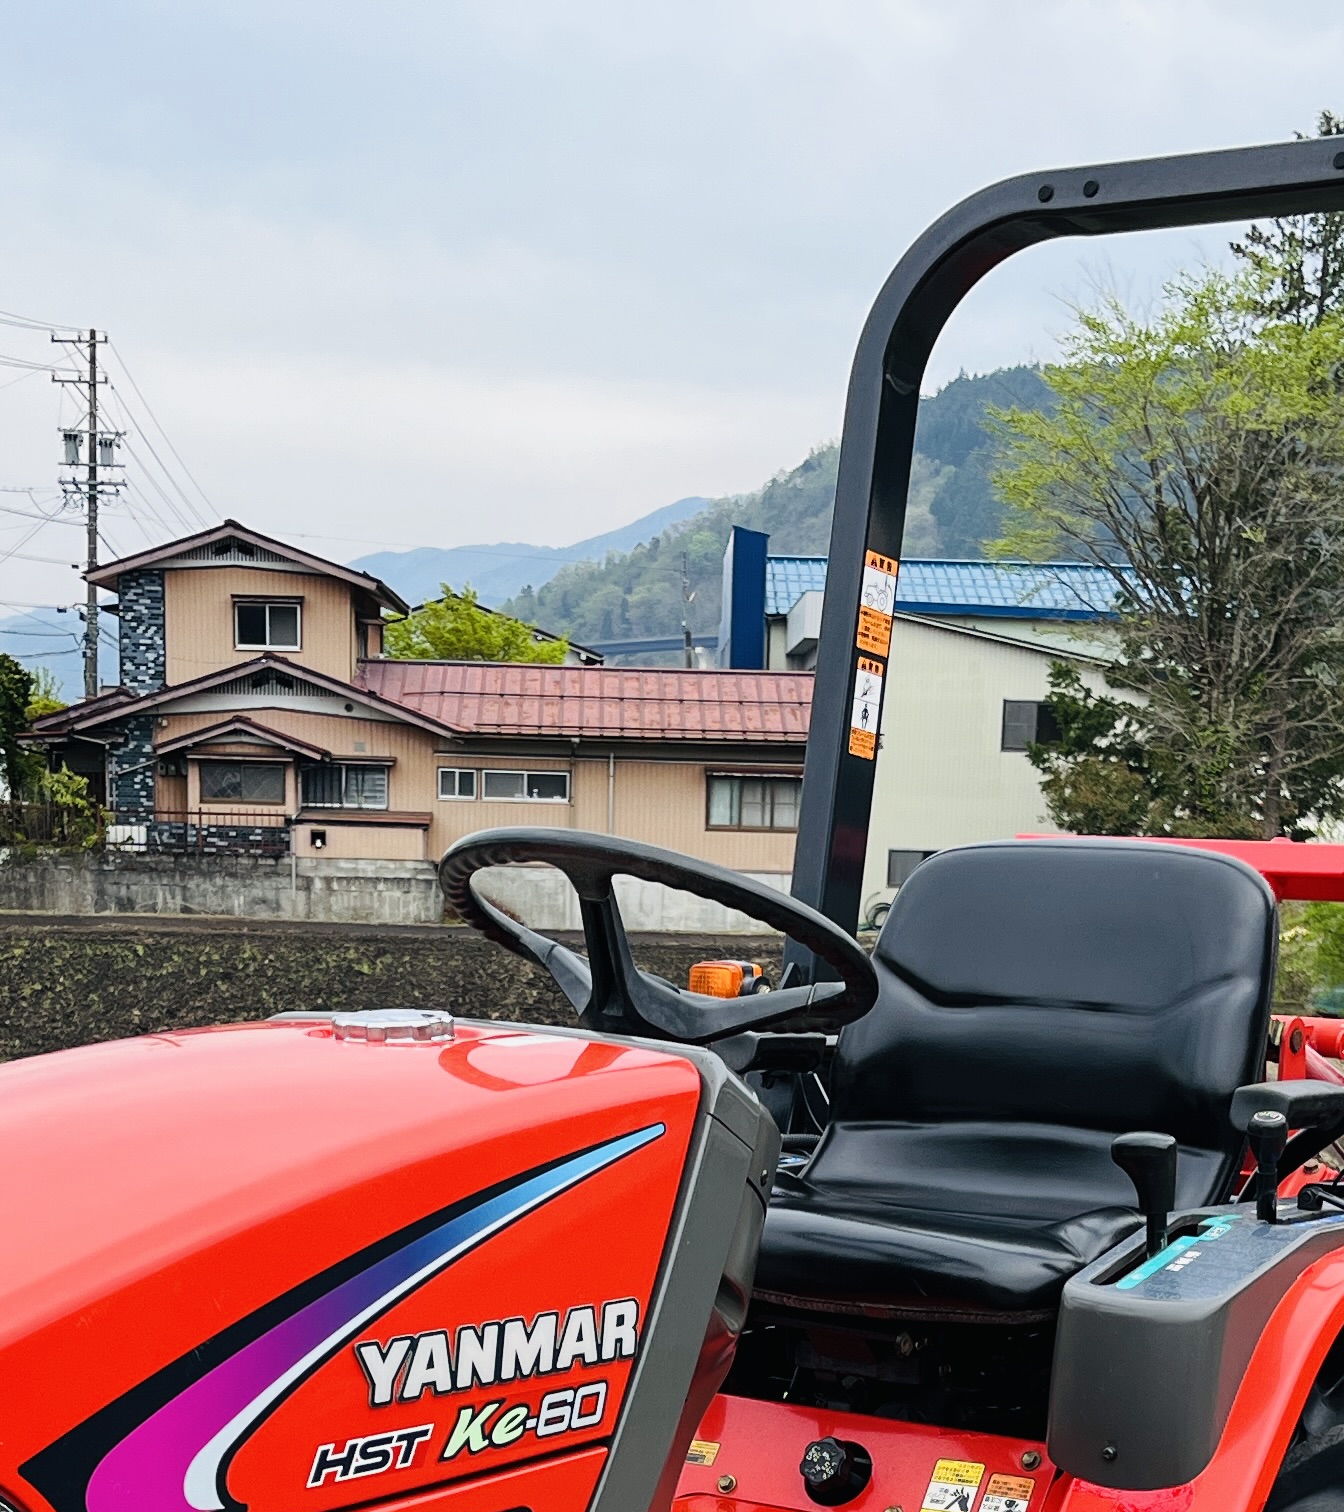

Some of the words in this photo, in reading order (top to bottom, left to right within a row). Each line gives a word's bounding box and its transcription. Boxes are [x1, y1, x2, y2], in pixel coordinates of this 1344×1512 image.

[359, 1297, 641, 1406] YANMAR
[307, 1425, 434, 1488] HST
[442, 1382, 608, 1459] Ke-60
